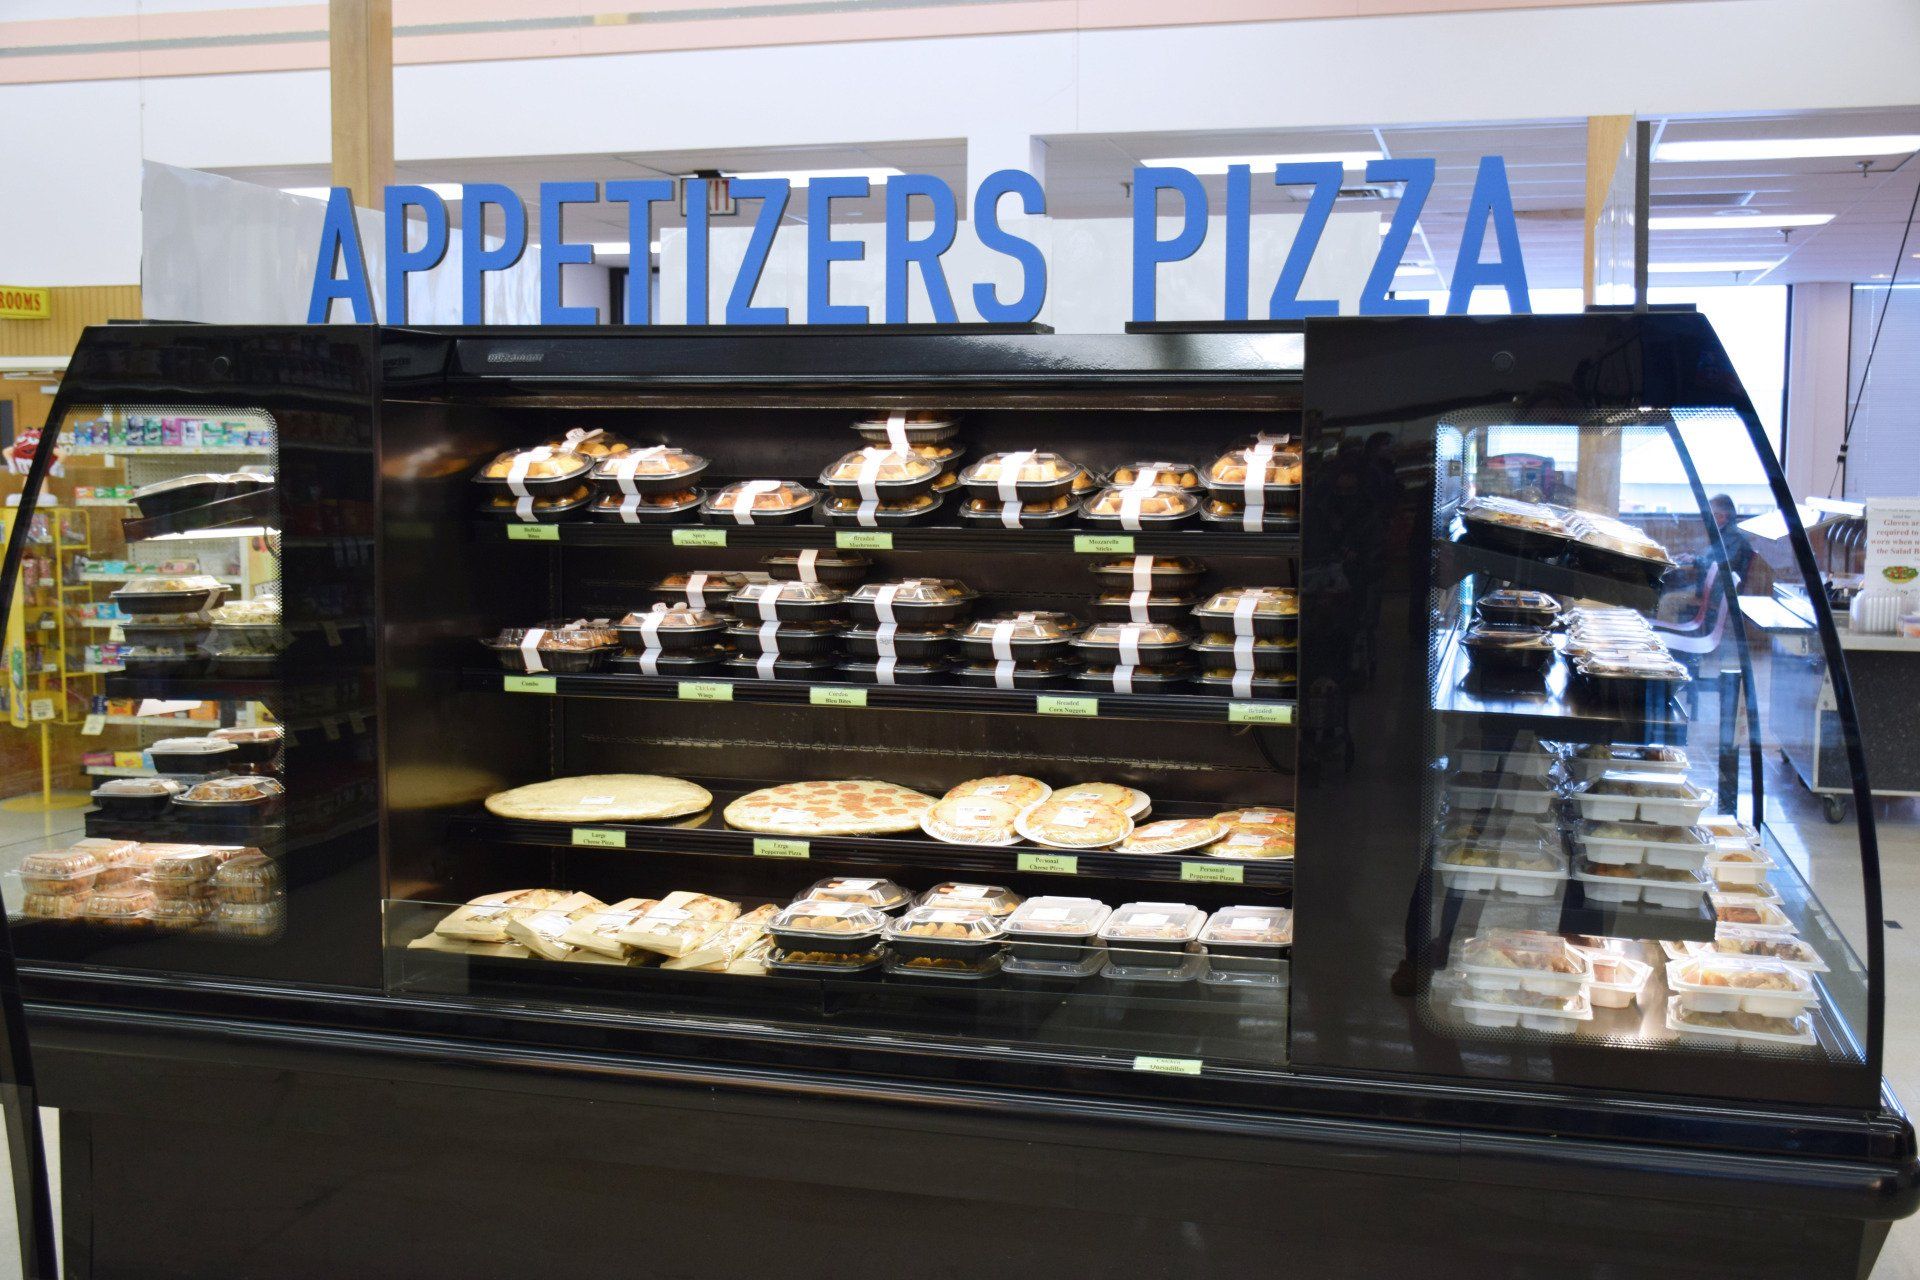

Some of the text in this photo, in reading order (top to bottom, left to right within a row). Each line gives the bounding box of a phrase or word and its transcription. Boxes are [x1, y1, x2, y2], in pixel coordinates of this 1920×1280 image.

[306, 155, 1533, 325] APPETIZERS PIZZA
[1876, 529, 1910, 537] required
[1150, 1064, 1185, 1072] Quesadillas
